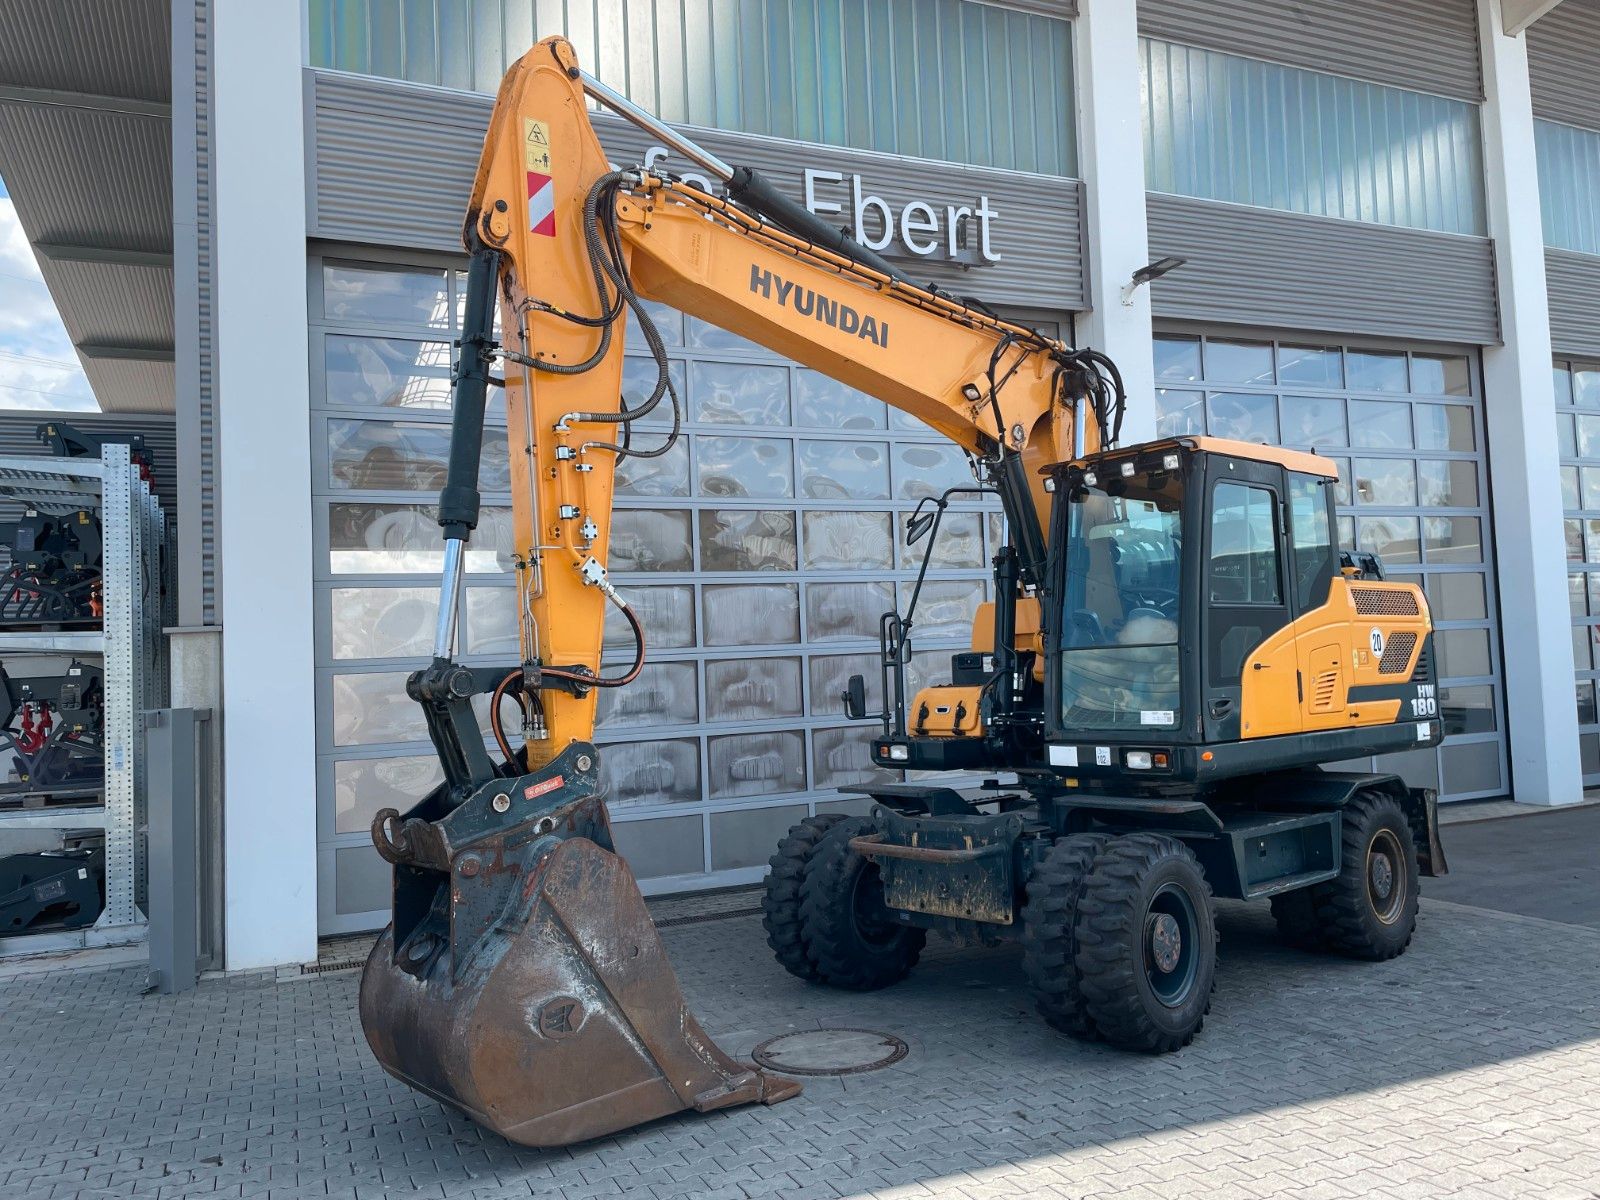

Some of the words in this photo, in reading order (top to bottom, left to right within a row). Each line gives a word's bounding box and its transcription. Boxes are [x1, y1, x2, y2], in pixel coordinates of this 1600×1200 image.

[803, 168, 1001, 262] Ebert
[750, 264, 889, 349] HYUNDAI
[1372, 633, 1382, 652] 20
[1417, 684, 1434, 698] HW
[1411, 698, 1436, 717] 180
